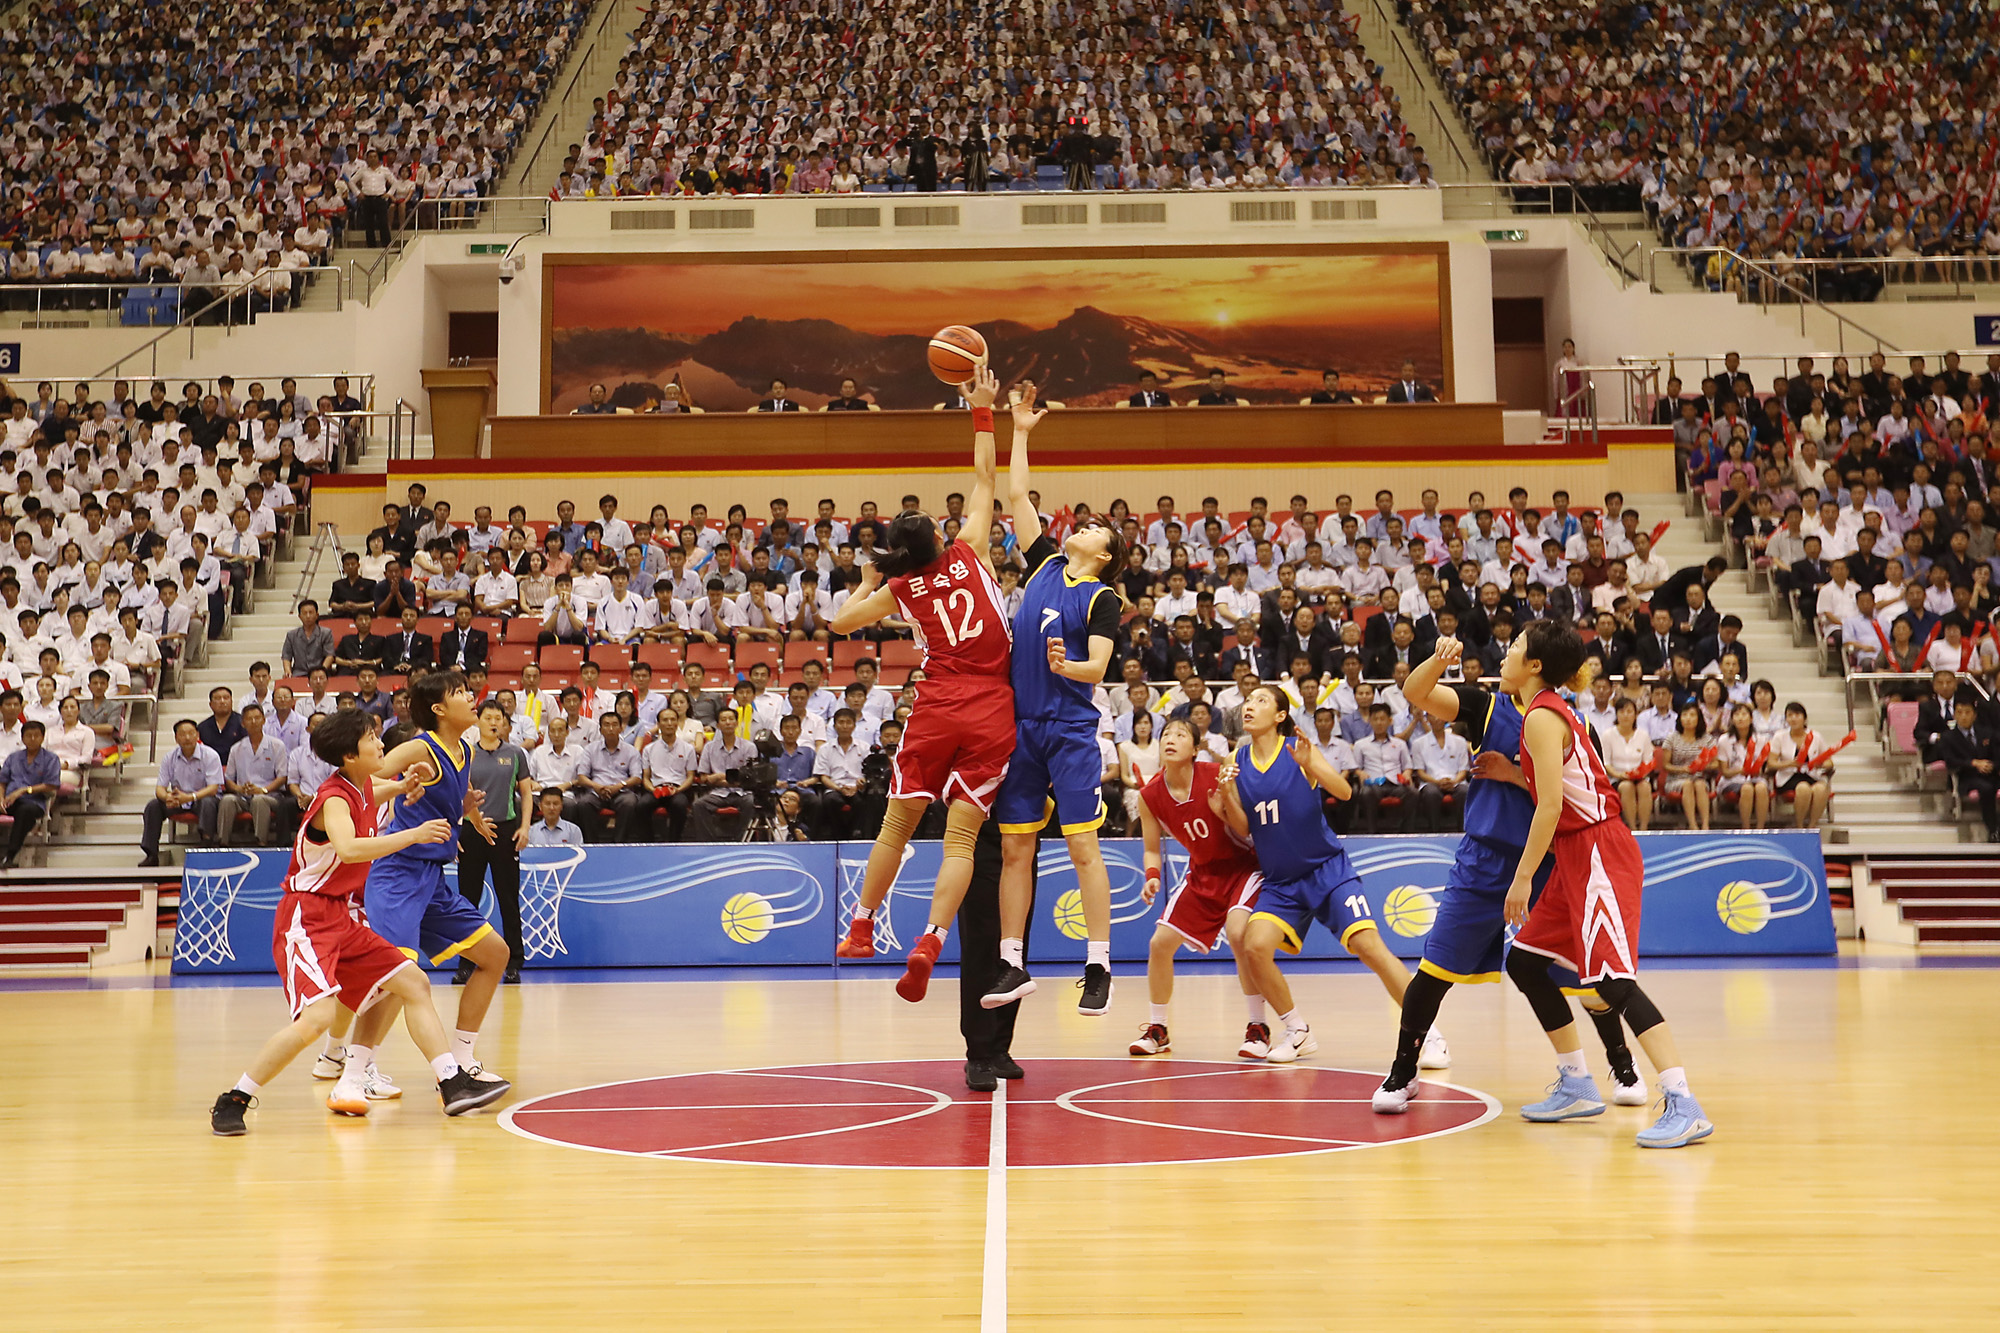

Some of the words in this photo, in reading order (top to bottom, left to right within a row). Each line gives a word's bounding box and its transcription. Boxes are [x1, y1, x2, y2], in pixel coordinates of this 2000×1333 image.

[0, 348, 12, 369] 6
[932, 588, 984, 647] 12
[1039, 607, 1061, 634] 7
[1094, 785, 1103, 816] 7
[1253, 799, 1280, 826] 11
[1183, 818, 1210, 842] 10
[1344, 894, 1372, 919] 11
